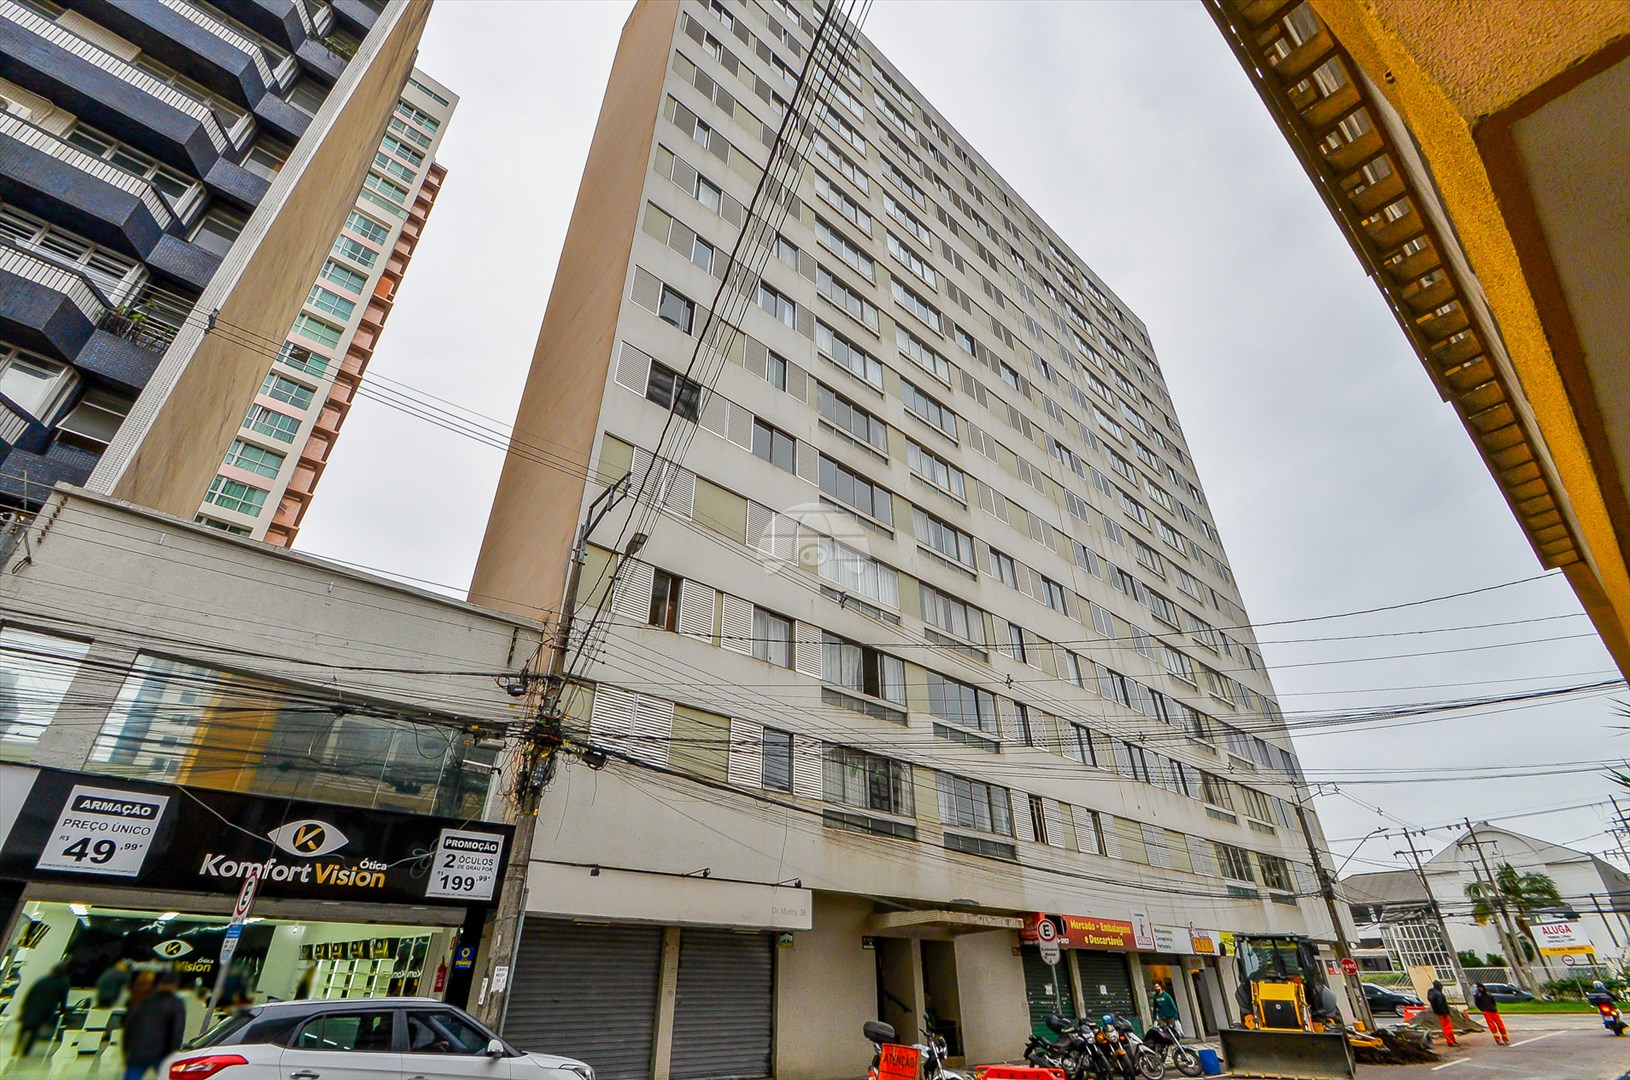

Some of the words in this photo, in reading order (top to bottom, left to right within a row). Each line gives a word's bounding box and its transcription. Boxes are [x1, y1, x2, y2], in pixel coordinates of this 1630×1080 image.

[80, 799, 151, 816] ARMAÇÃO
[62, 818, 108, 832] PREÇO
[111, 822, 151, 836] ÚNICO
[62, 837, 116, 865] 49
[445, 838, 497, 852] PROMOÇÃO
[360, 858, 387, 871] Ótica
[443, 854, 457, 868] 2
[459, 855, 494, 866] ÓCULOS
[199, 853, 312, 883] Komfort
[315, 863, 385, 888] Vision
[440, 875, 475, 891] 199
[241, 880, 253, 905] E
[1042, 924, 1051, 937] E
[1070, 920, 1095, 930] Mercado
[1100, 922, 1131, 935] Embalagens
[1542, 924, 1572, 935] ALUGA
[1084, 936, 1089, 944] e
[1089, 934, 1124, 946] Descartáveis
[884, 1053, 914, 1069] ATENÇÃO
